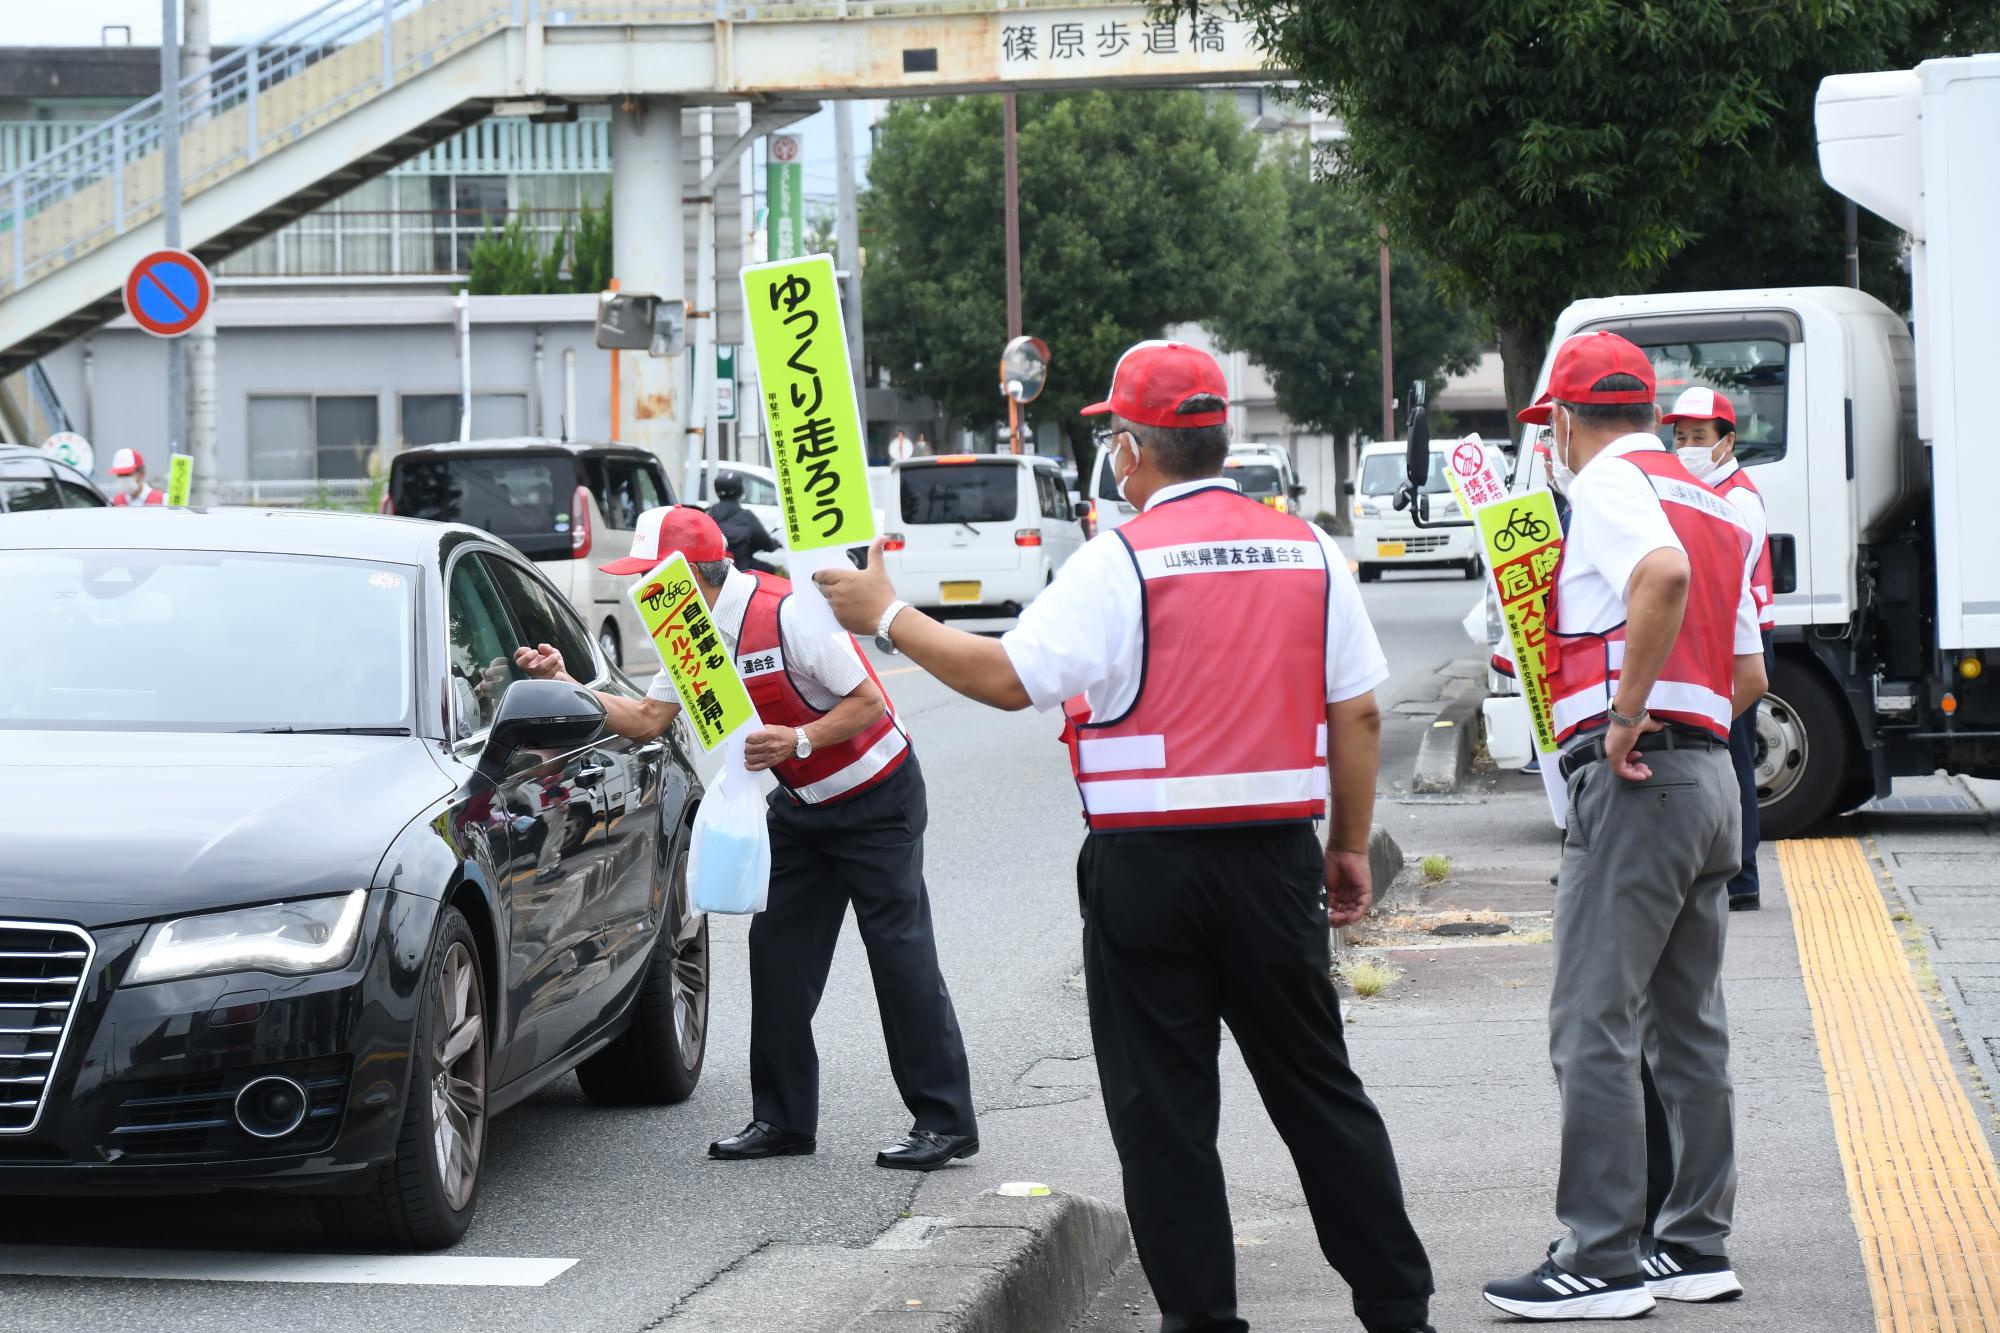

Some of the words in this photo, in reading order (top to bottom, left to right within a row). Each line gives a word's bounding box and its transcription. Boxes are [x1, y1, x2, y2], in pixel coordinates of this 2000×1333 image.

[1002, 16, 1225, 61] 篠原歩道橋
[769, 273, 844, 538] ゆっくり走ろう
[1163, 546, 1305, 569] 山梨県警友会連合会
[681, 600, 725, 671] 自転車も
[742, 655, 776, 675] 連合会
